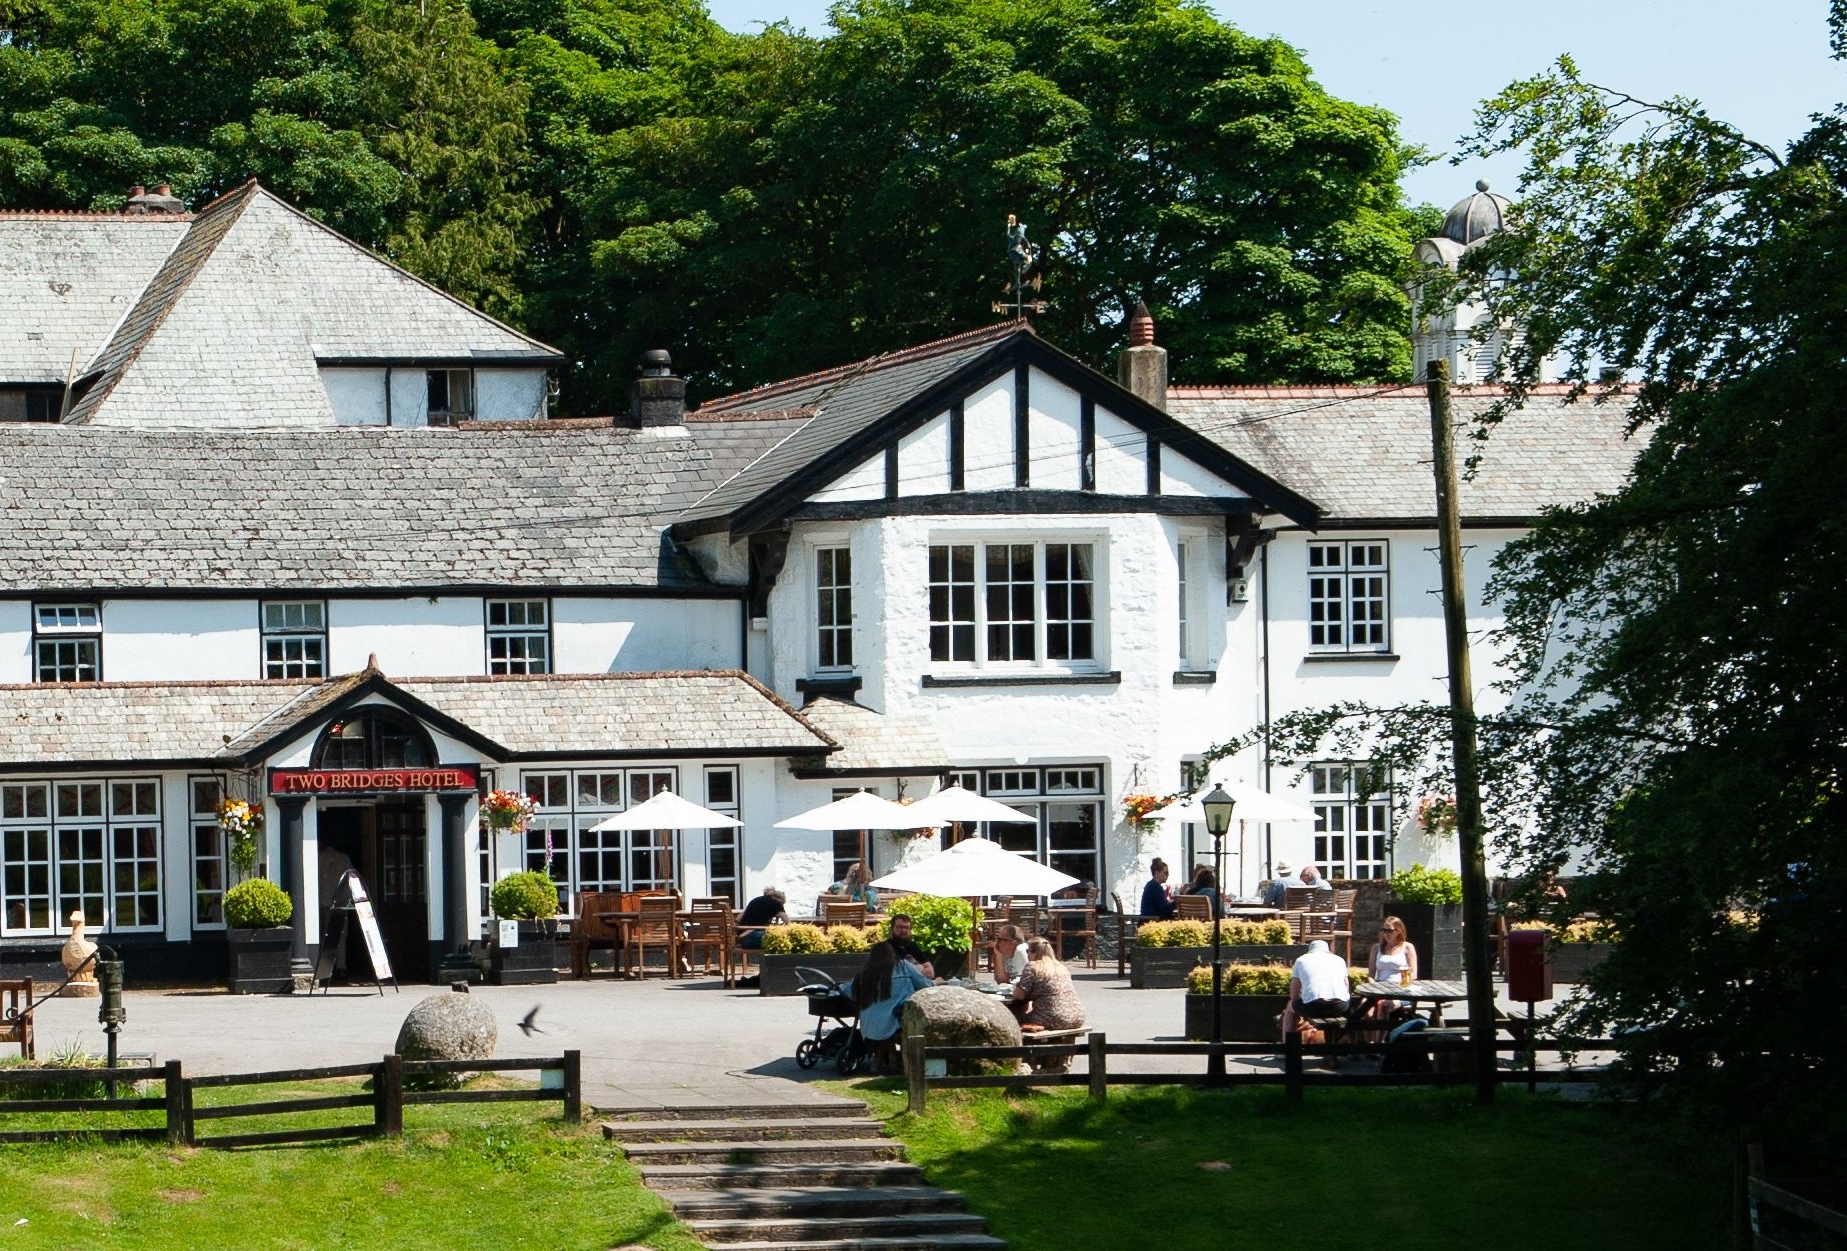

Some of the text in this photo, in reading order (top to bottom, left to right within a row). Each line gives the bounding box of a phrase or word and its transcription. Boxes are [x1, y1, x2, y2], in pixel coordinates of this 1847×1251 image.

[286, 772, 464, 789] TWO BRIDGES HOTEL
